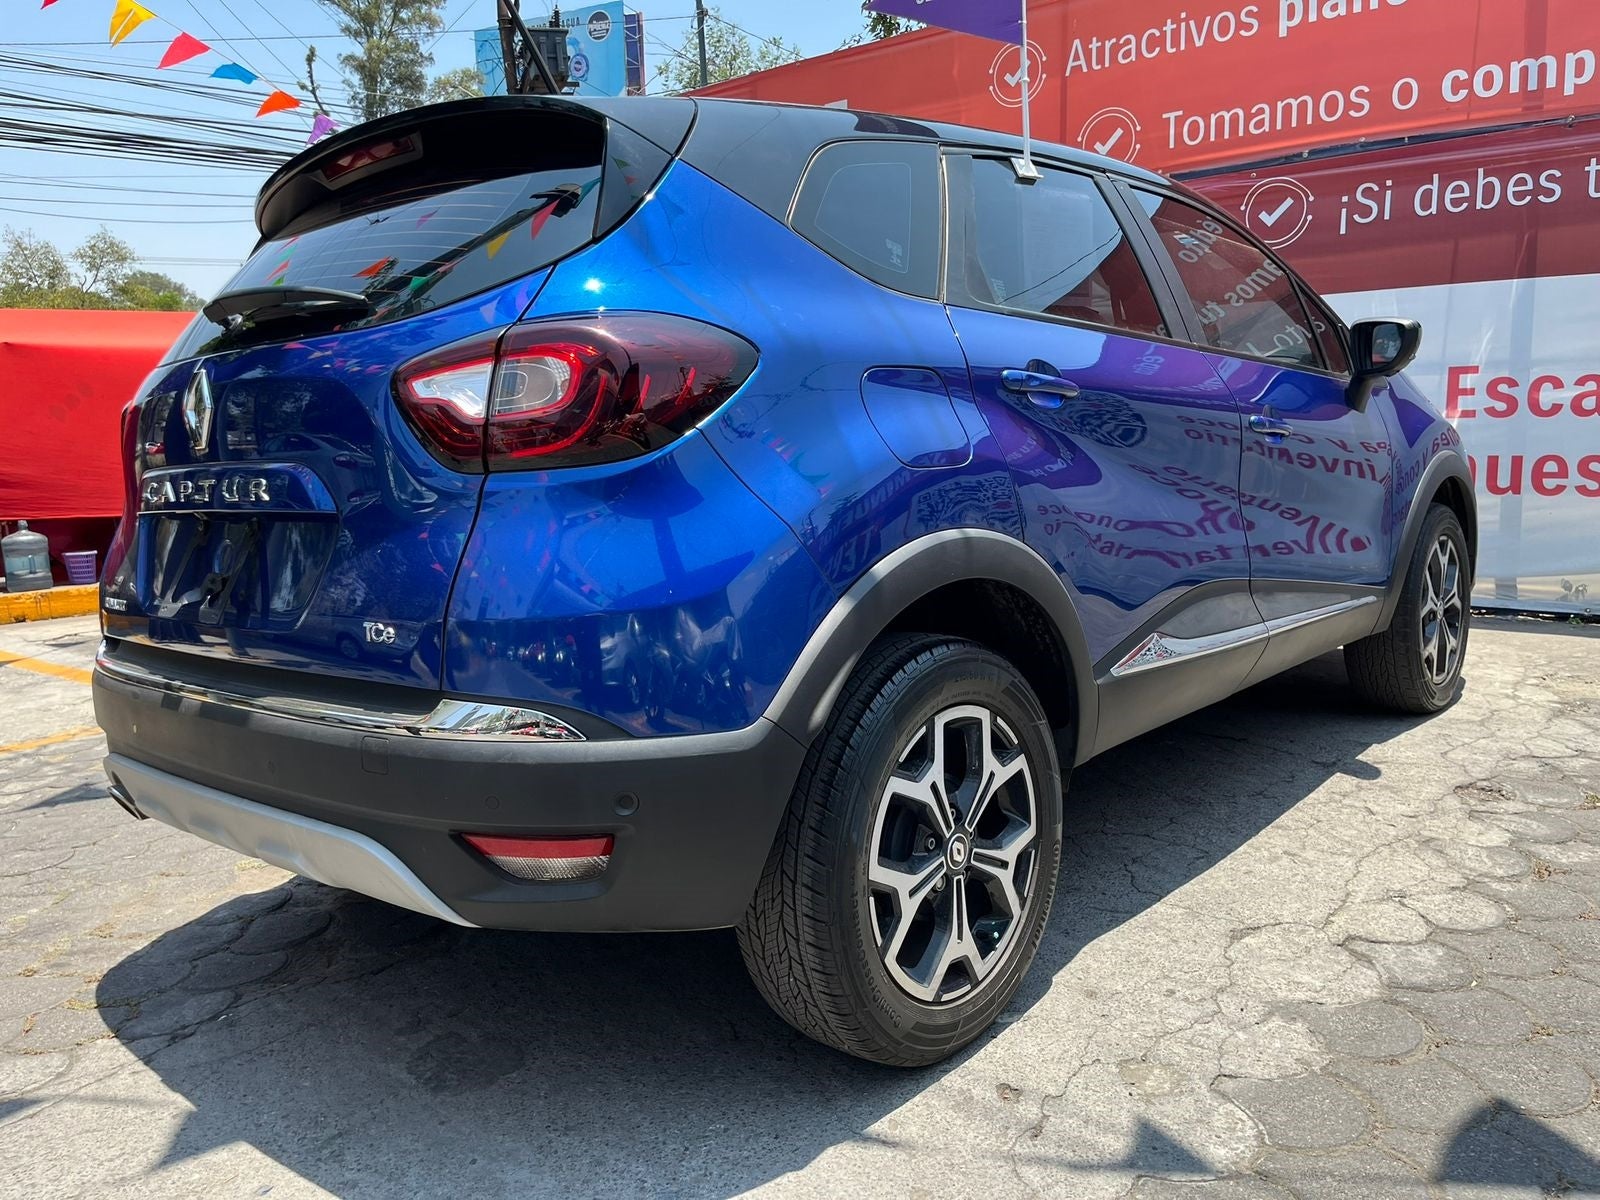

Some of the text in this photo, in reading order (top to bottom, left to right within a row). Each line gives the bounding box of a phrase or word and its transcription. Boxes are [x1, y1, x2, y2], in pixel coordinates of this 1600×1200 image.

[1065, 0, 1407, 77] Atractivos pla
[1162, 49, 1596, 149] Tomamos o comp
[1339, 180, 1393, 235] ¡Si
[1414, 166, 1562, 217] debes
[1445, 365, 1600, 418] Esca
[143, 478, 270, 502] CAPTUR
[363, 621, 396, 644] TCe
